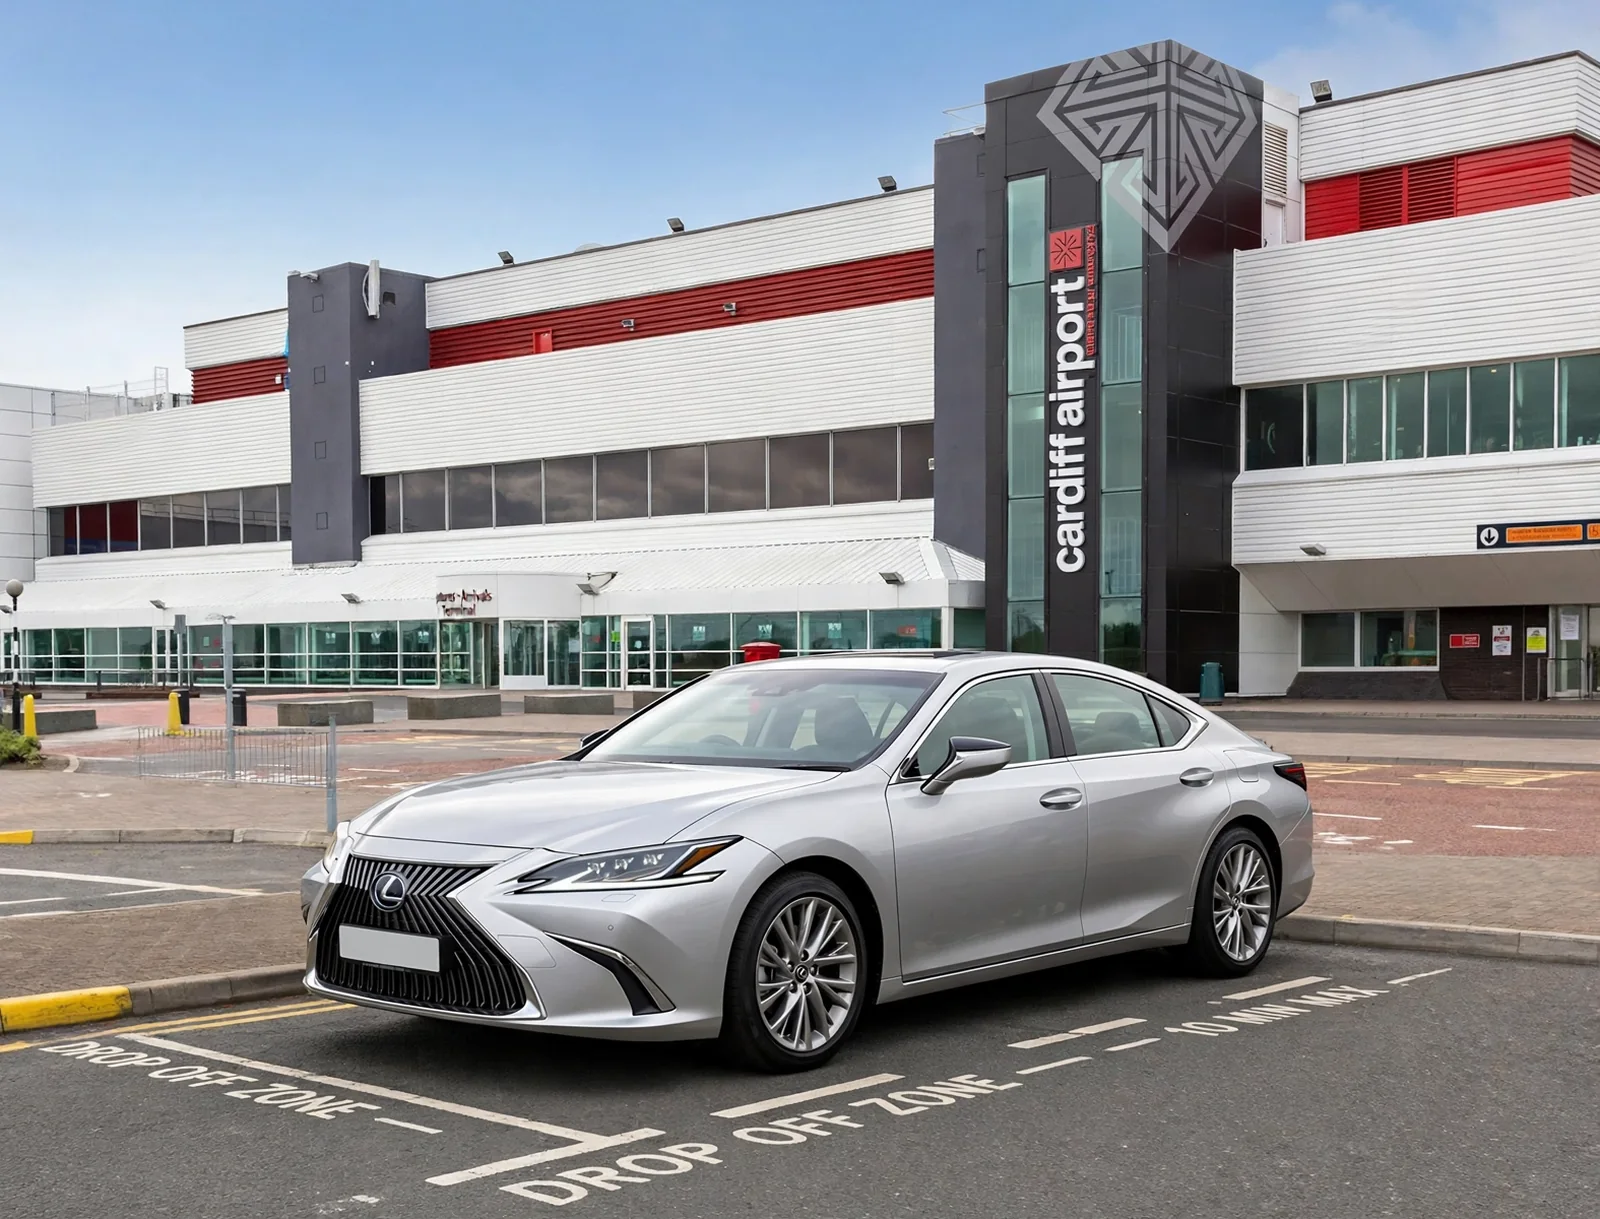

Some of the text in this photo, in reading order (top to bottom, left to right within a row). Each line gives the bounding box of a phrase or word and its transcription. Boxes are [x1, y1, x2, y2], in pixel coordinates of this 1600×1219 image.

[1049, 275, 1095, 573] cardiff airport
[1163, 985, 1390, 1036] 10 MIN MAX
[38, 1040, 382, 1120] DROP OFF ZONE
[499, 1074, 1023, 1206] DROP OFF ZONE
